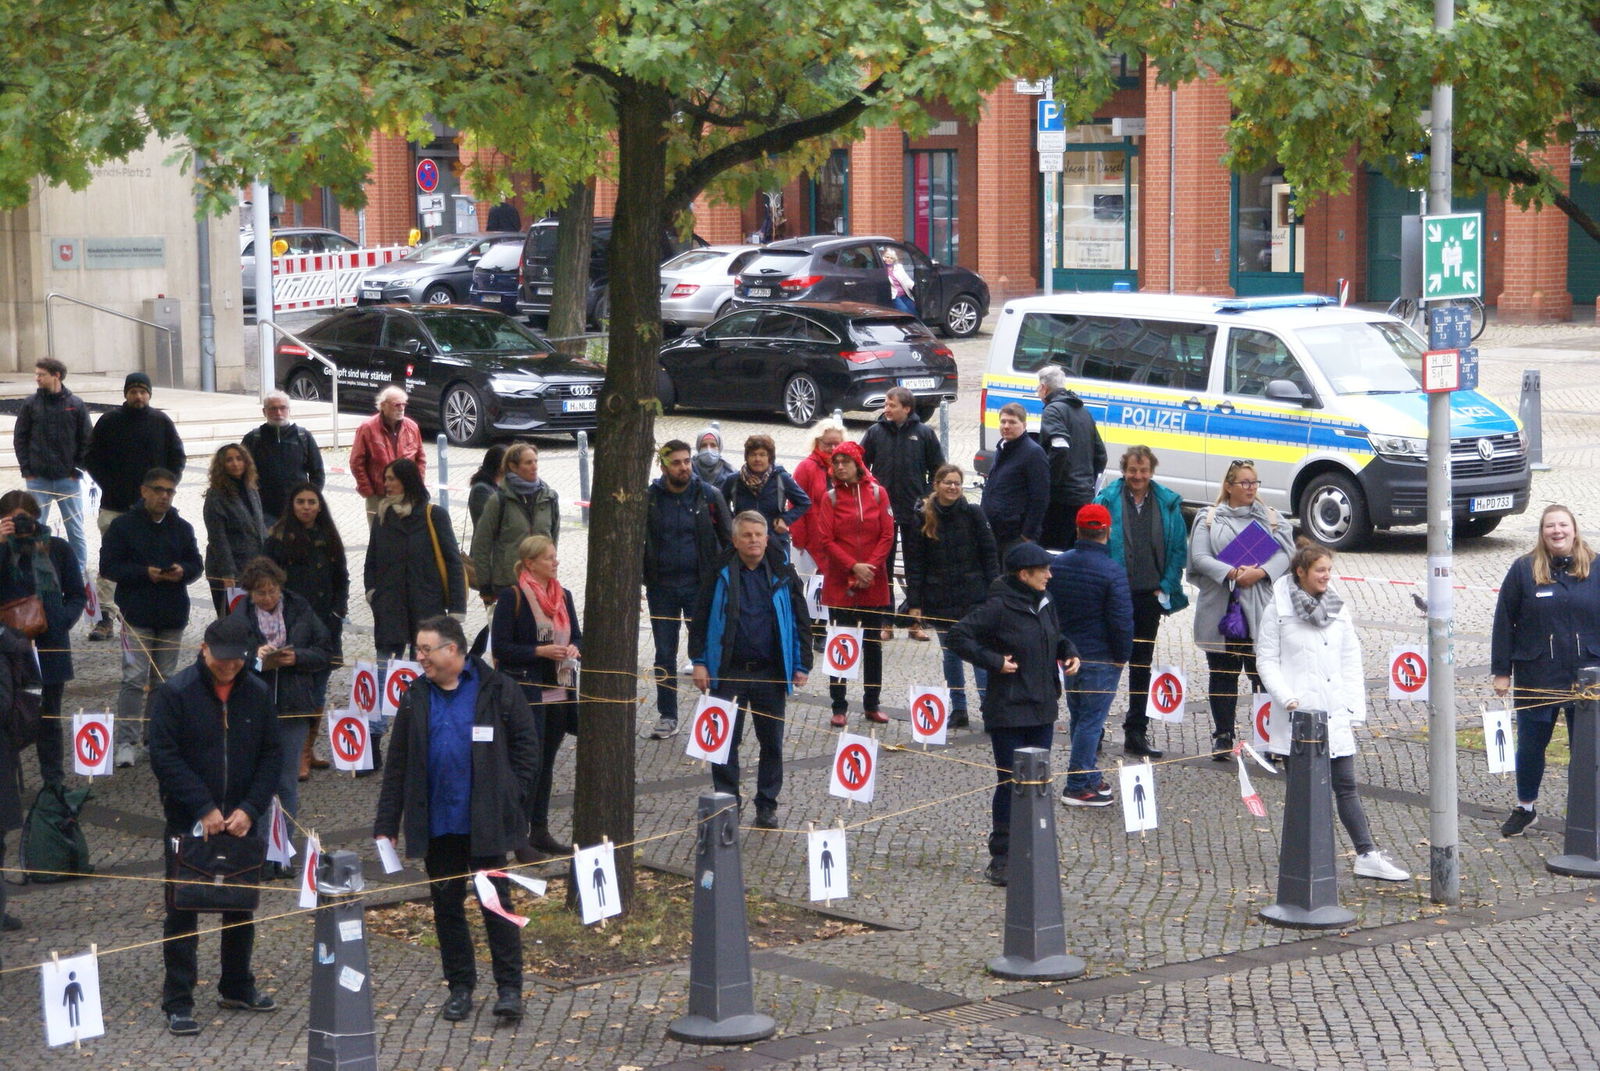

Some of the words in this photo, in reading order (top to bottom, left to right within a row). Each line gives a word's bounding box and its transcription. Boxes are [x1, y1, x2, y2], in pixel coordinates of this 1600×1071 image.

[93, 168, 145, 177] rendt-Platz
[323, 366, 348, 378] Gepft
[347, 368, 360, 378] sind
[360, 370, 371, 379] wir
[371, 371, 392, 382] stärker!
[1121, 406, 1187, 430] POLIZEI
[1476, 500, 1483, 509] H
[1496, 496, 1511, 507] 733
